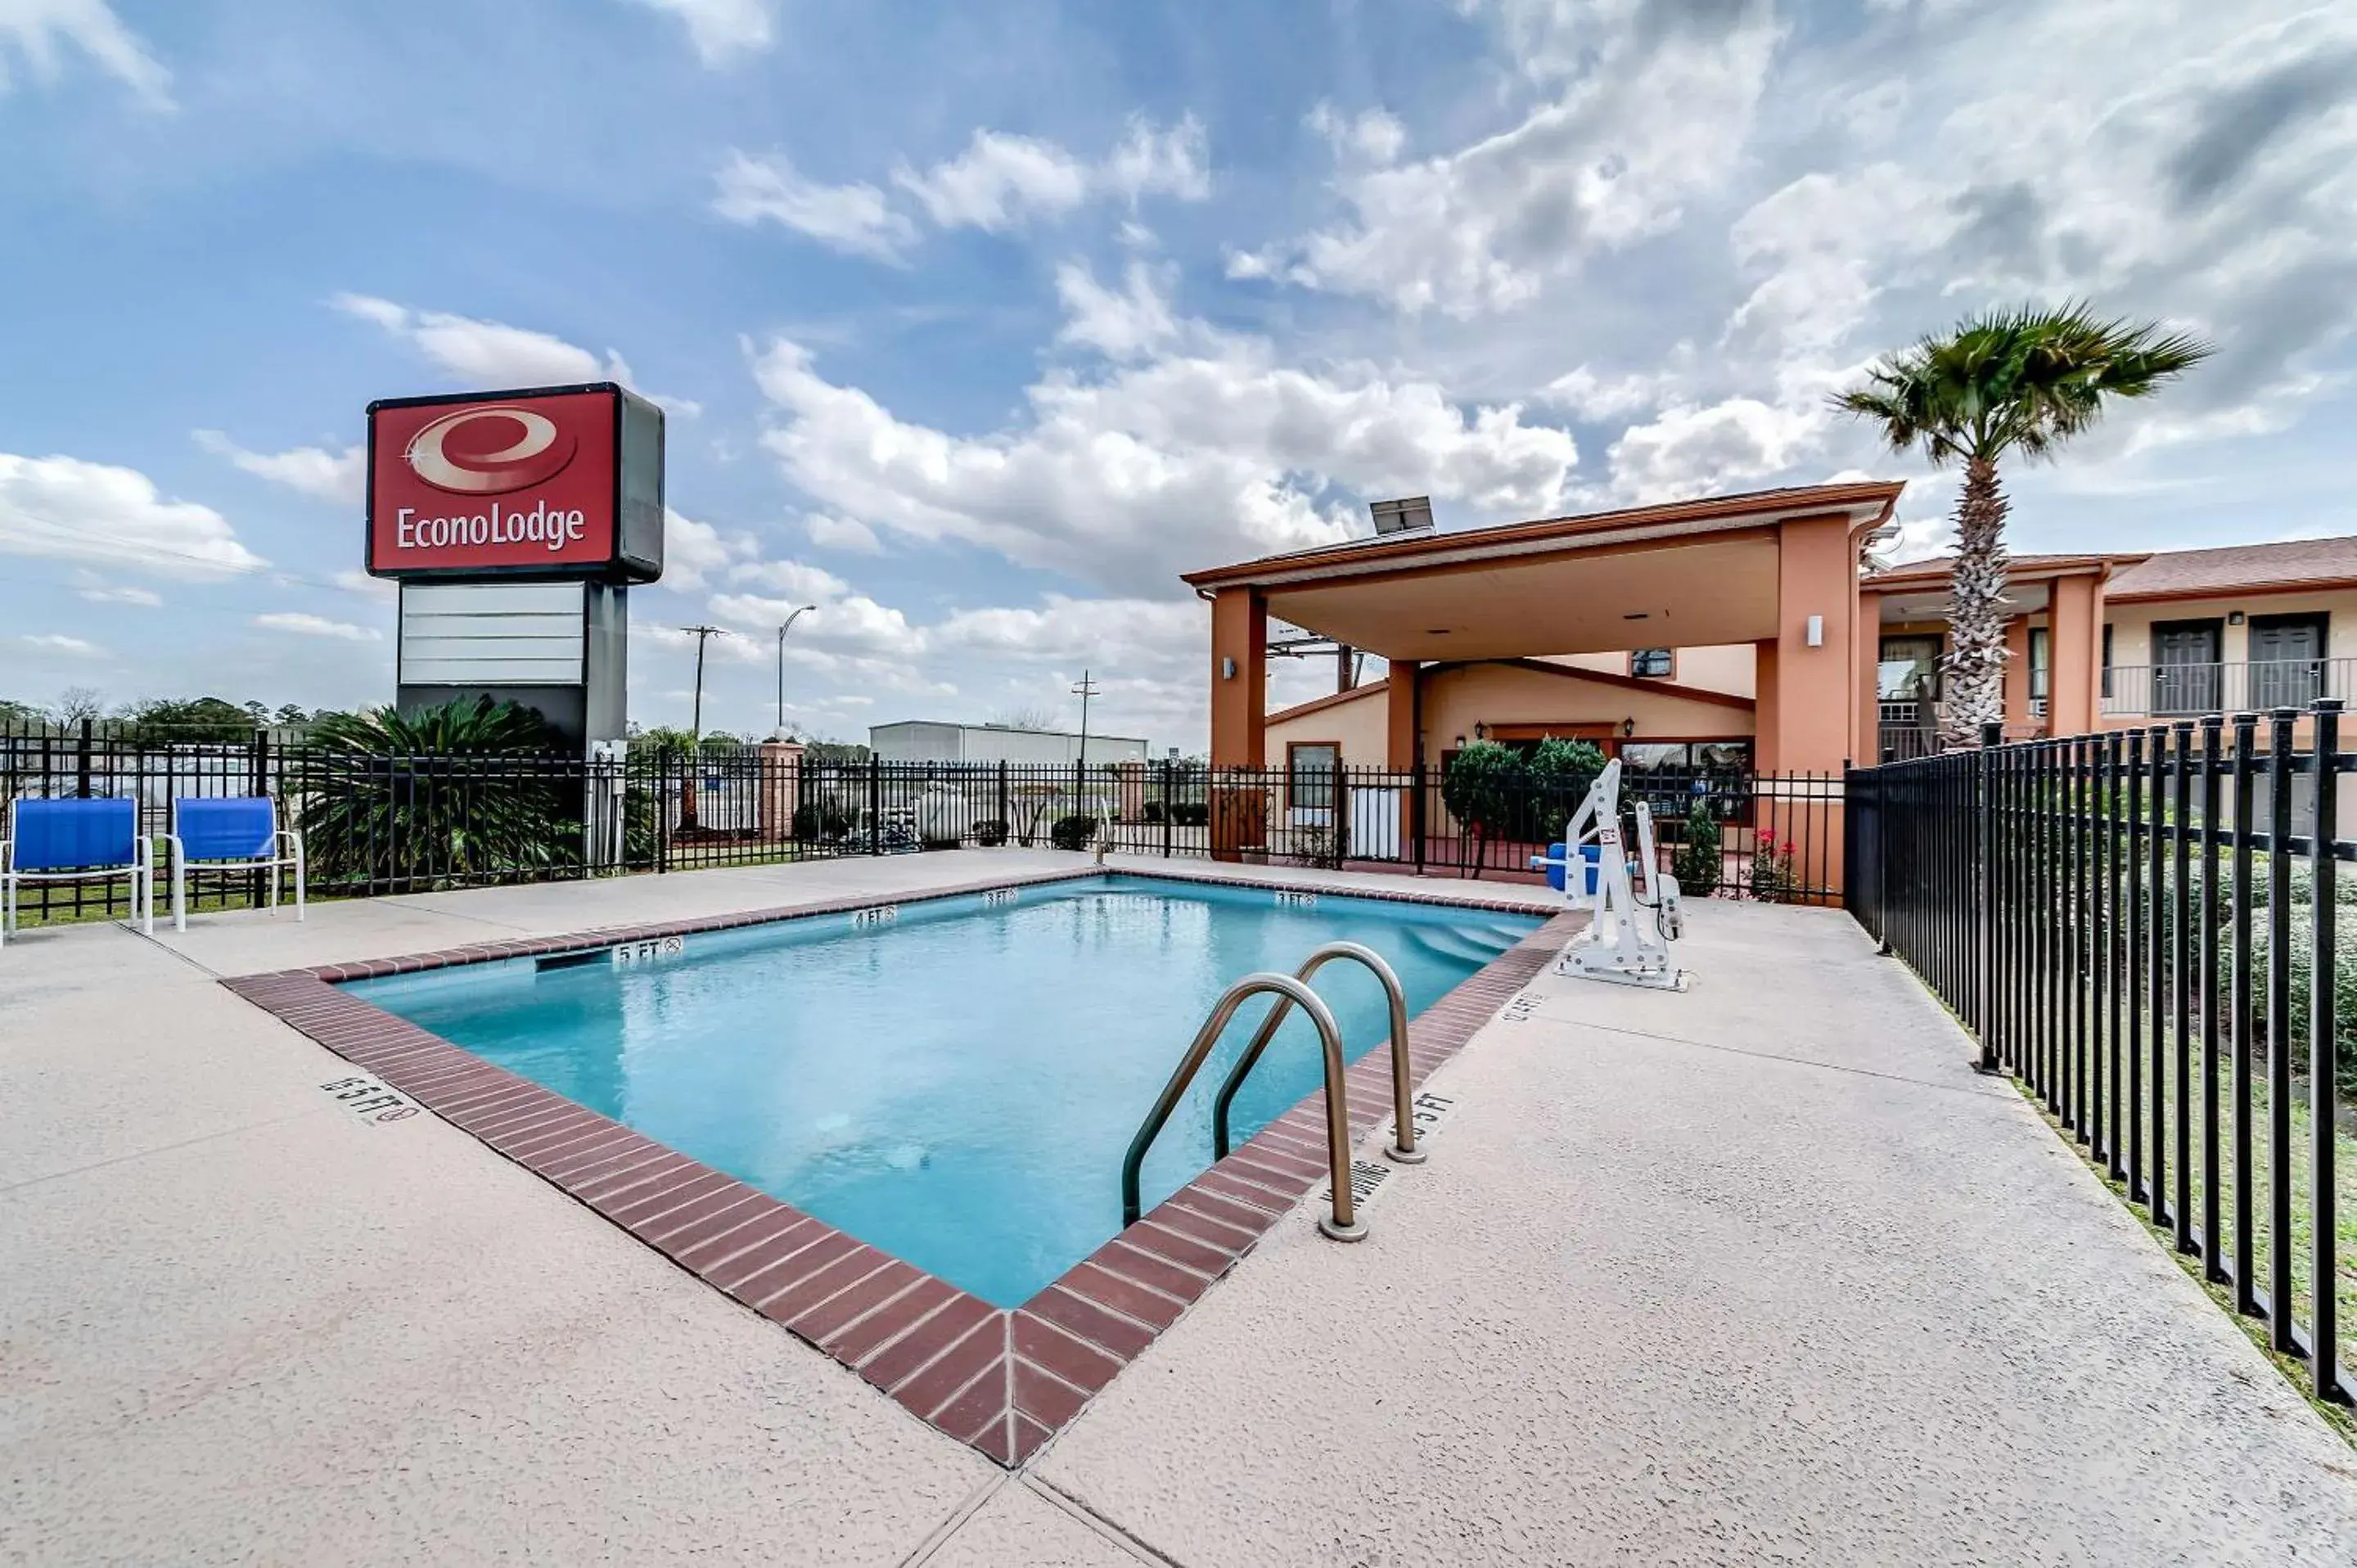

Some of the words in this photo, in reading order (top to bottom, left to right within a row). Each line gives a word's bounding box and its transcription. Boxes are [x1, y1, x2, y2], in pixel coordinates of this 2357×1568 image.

[619, 946, 631, 963] 5
[638, 940, 660, 957] FT
[1413, 1093, 1454, 1112] FT
